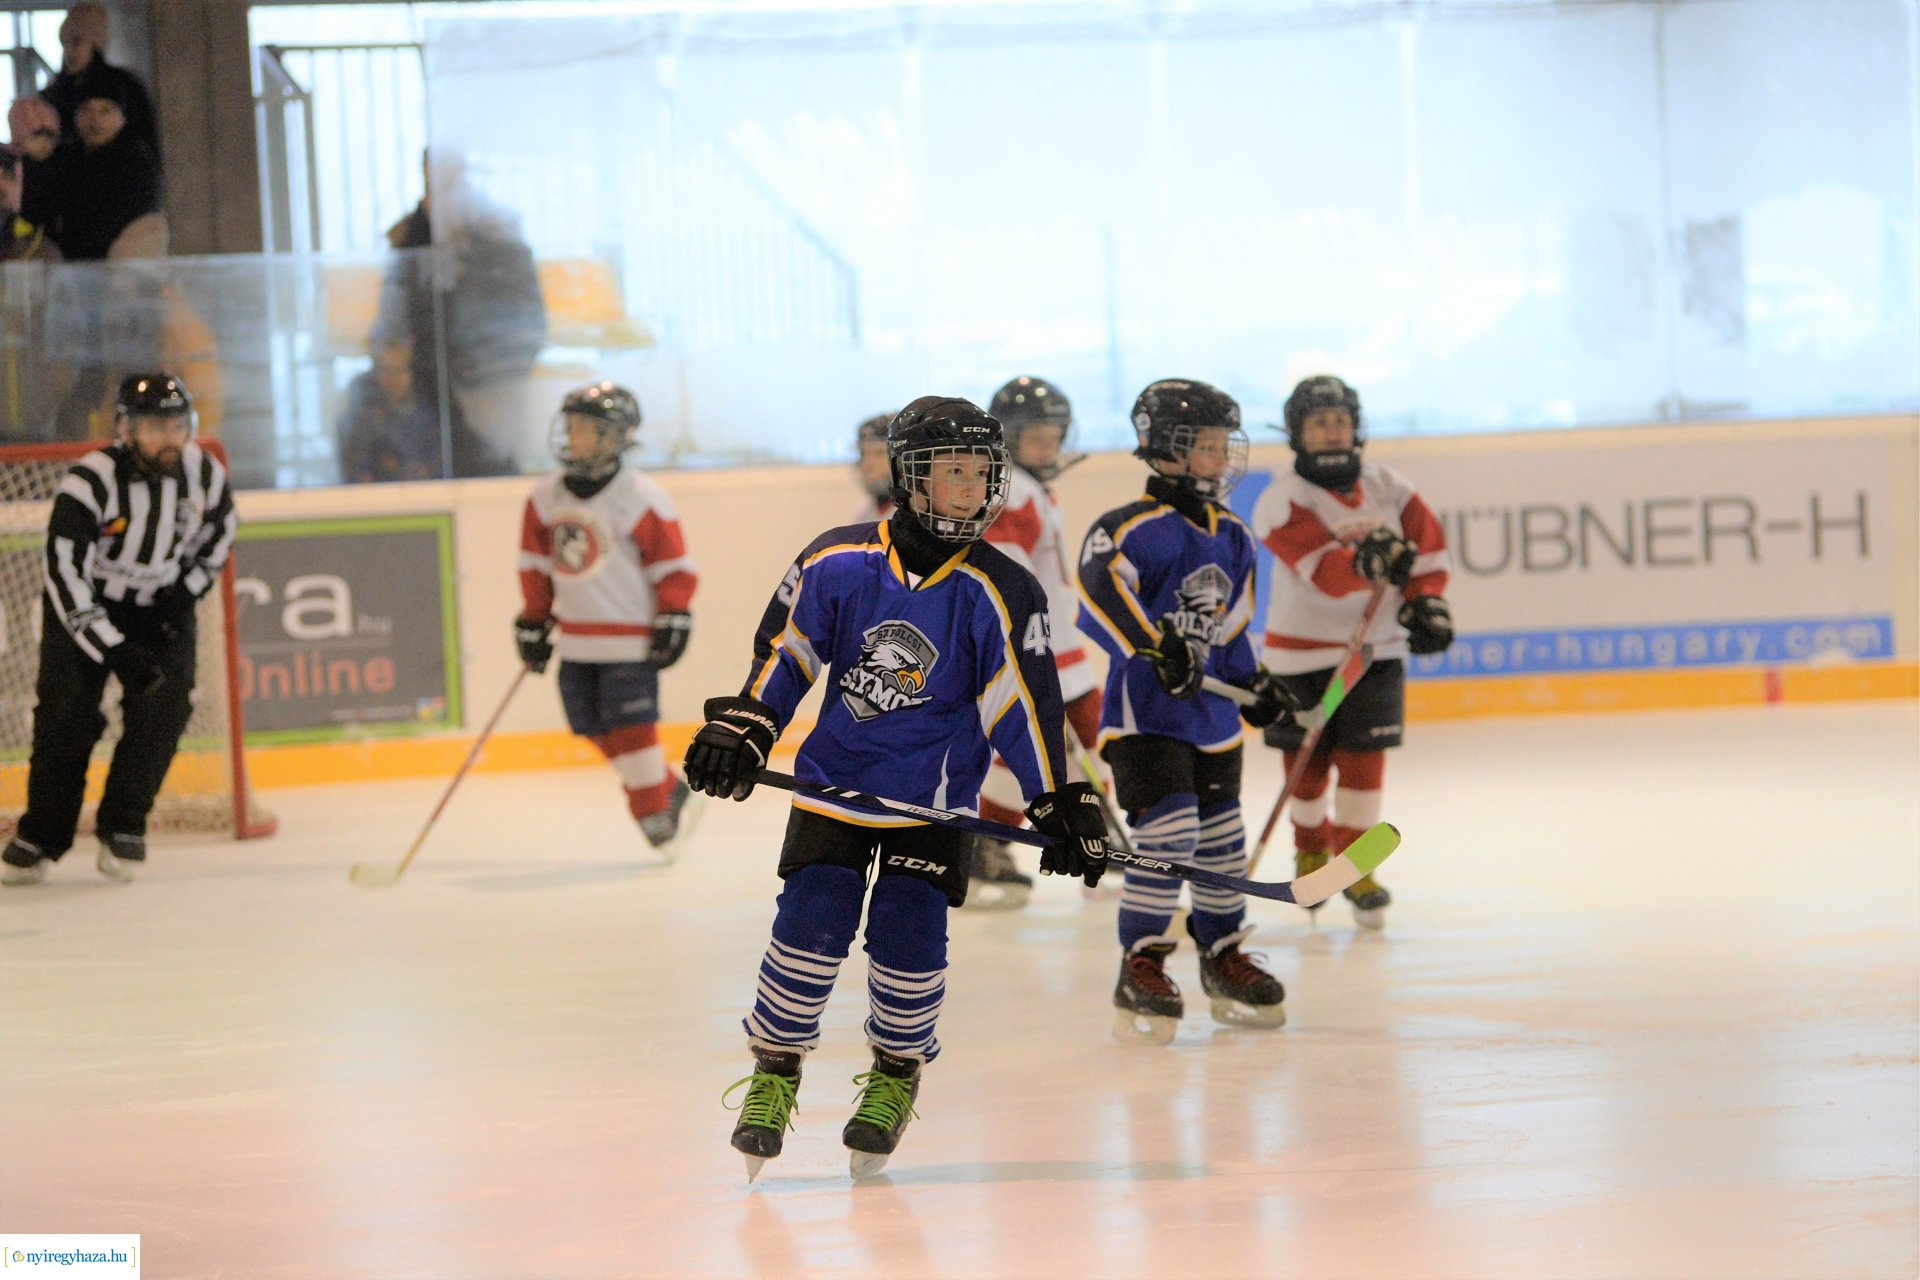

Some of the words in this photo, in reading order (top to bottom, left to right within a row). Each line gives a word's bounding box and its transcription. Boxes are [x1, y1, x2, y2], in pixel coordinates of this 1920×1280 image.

[1441, 491, 1870, 576] ÜBNER-H
[887, 855, 947, 875] CCM
[1106, 849, 1172, 872] SCHER
[761, 1053, 785, 1062] CCM
